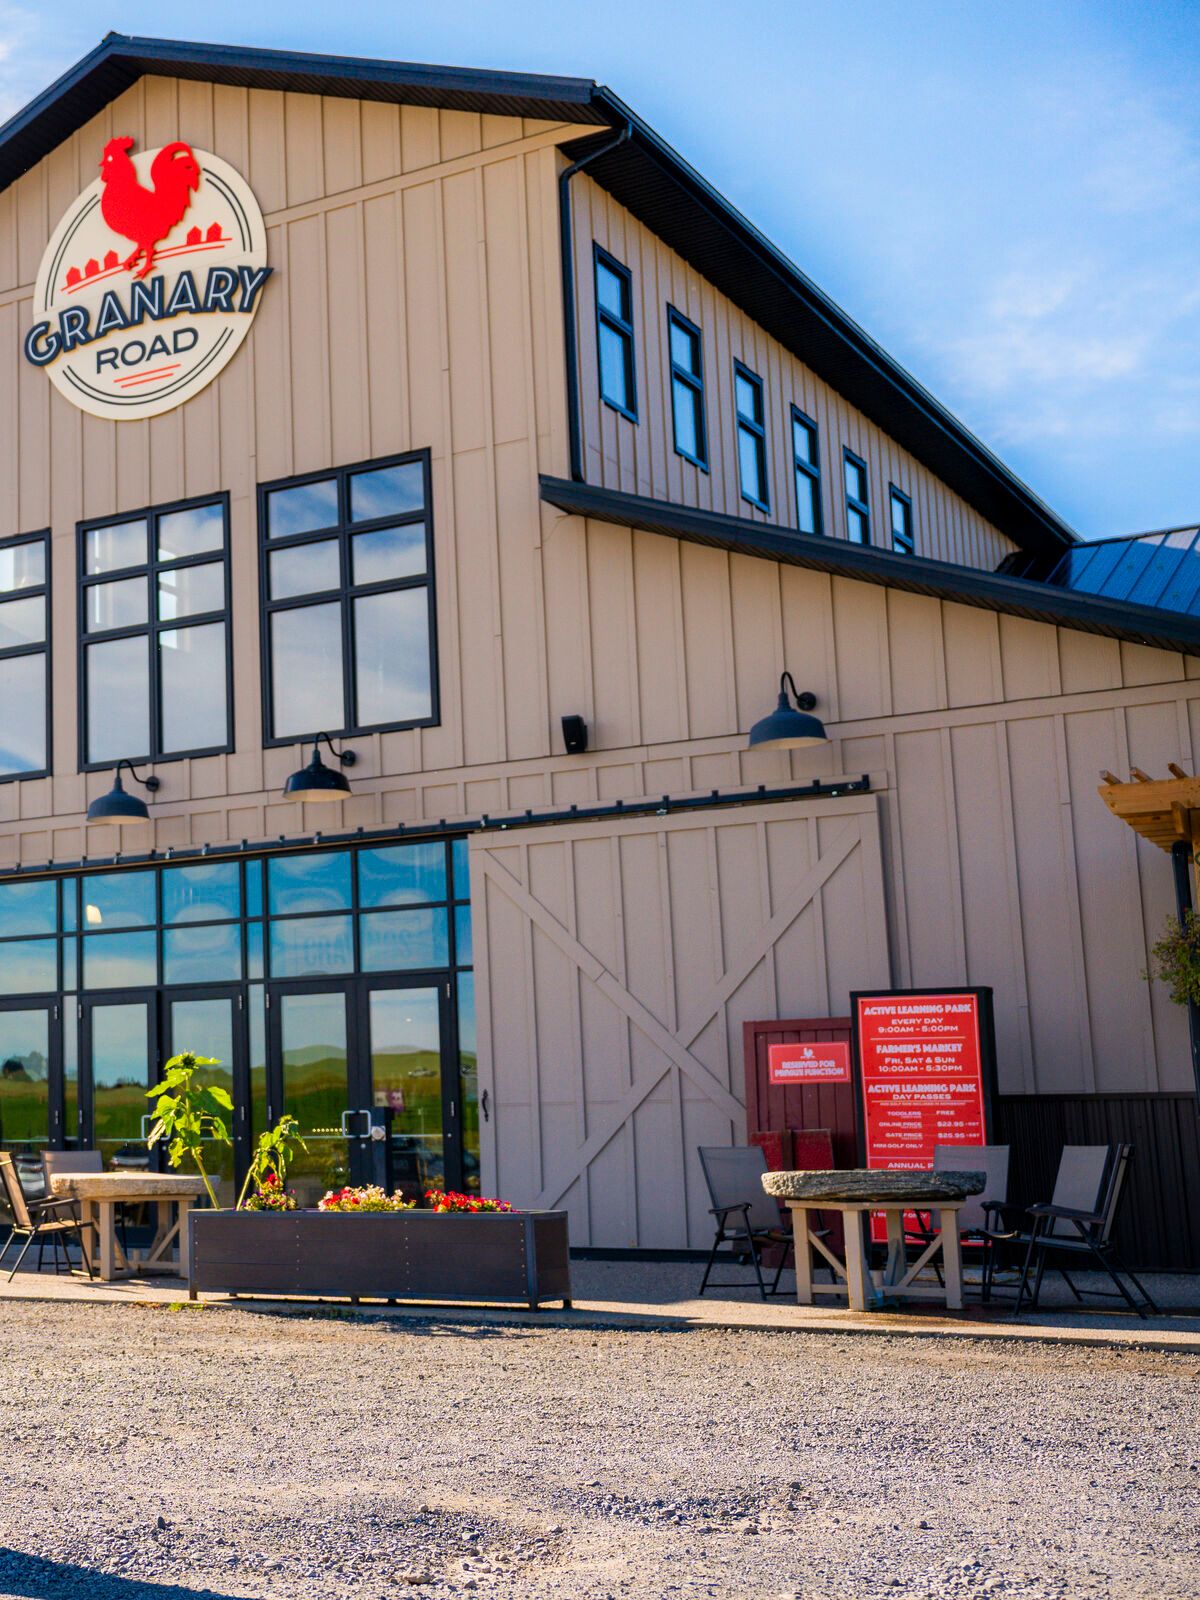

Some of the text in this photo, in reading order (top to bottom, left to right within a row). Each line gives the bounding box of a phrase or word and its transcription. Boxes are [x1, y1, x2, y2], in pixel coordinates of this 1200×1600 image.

[24, 265, 274, 367] GRANARY
[96, 327, 199, 374] ROAD
[864, 1004, 972, 1015] ACTIVE LEARNING PARK
[876, 1043, 963, 1054] FARMER'S MARKET
[925, 1064, 963, 1072] 5:30PM
[868, 1083, 977, 1093] ACTIVE LEARNING PARK
